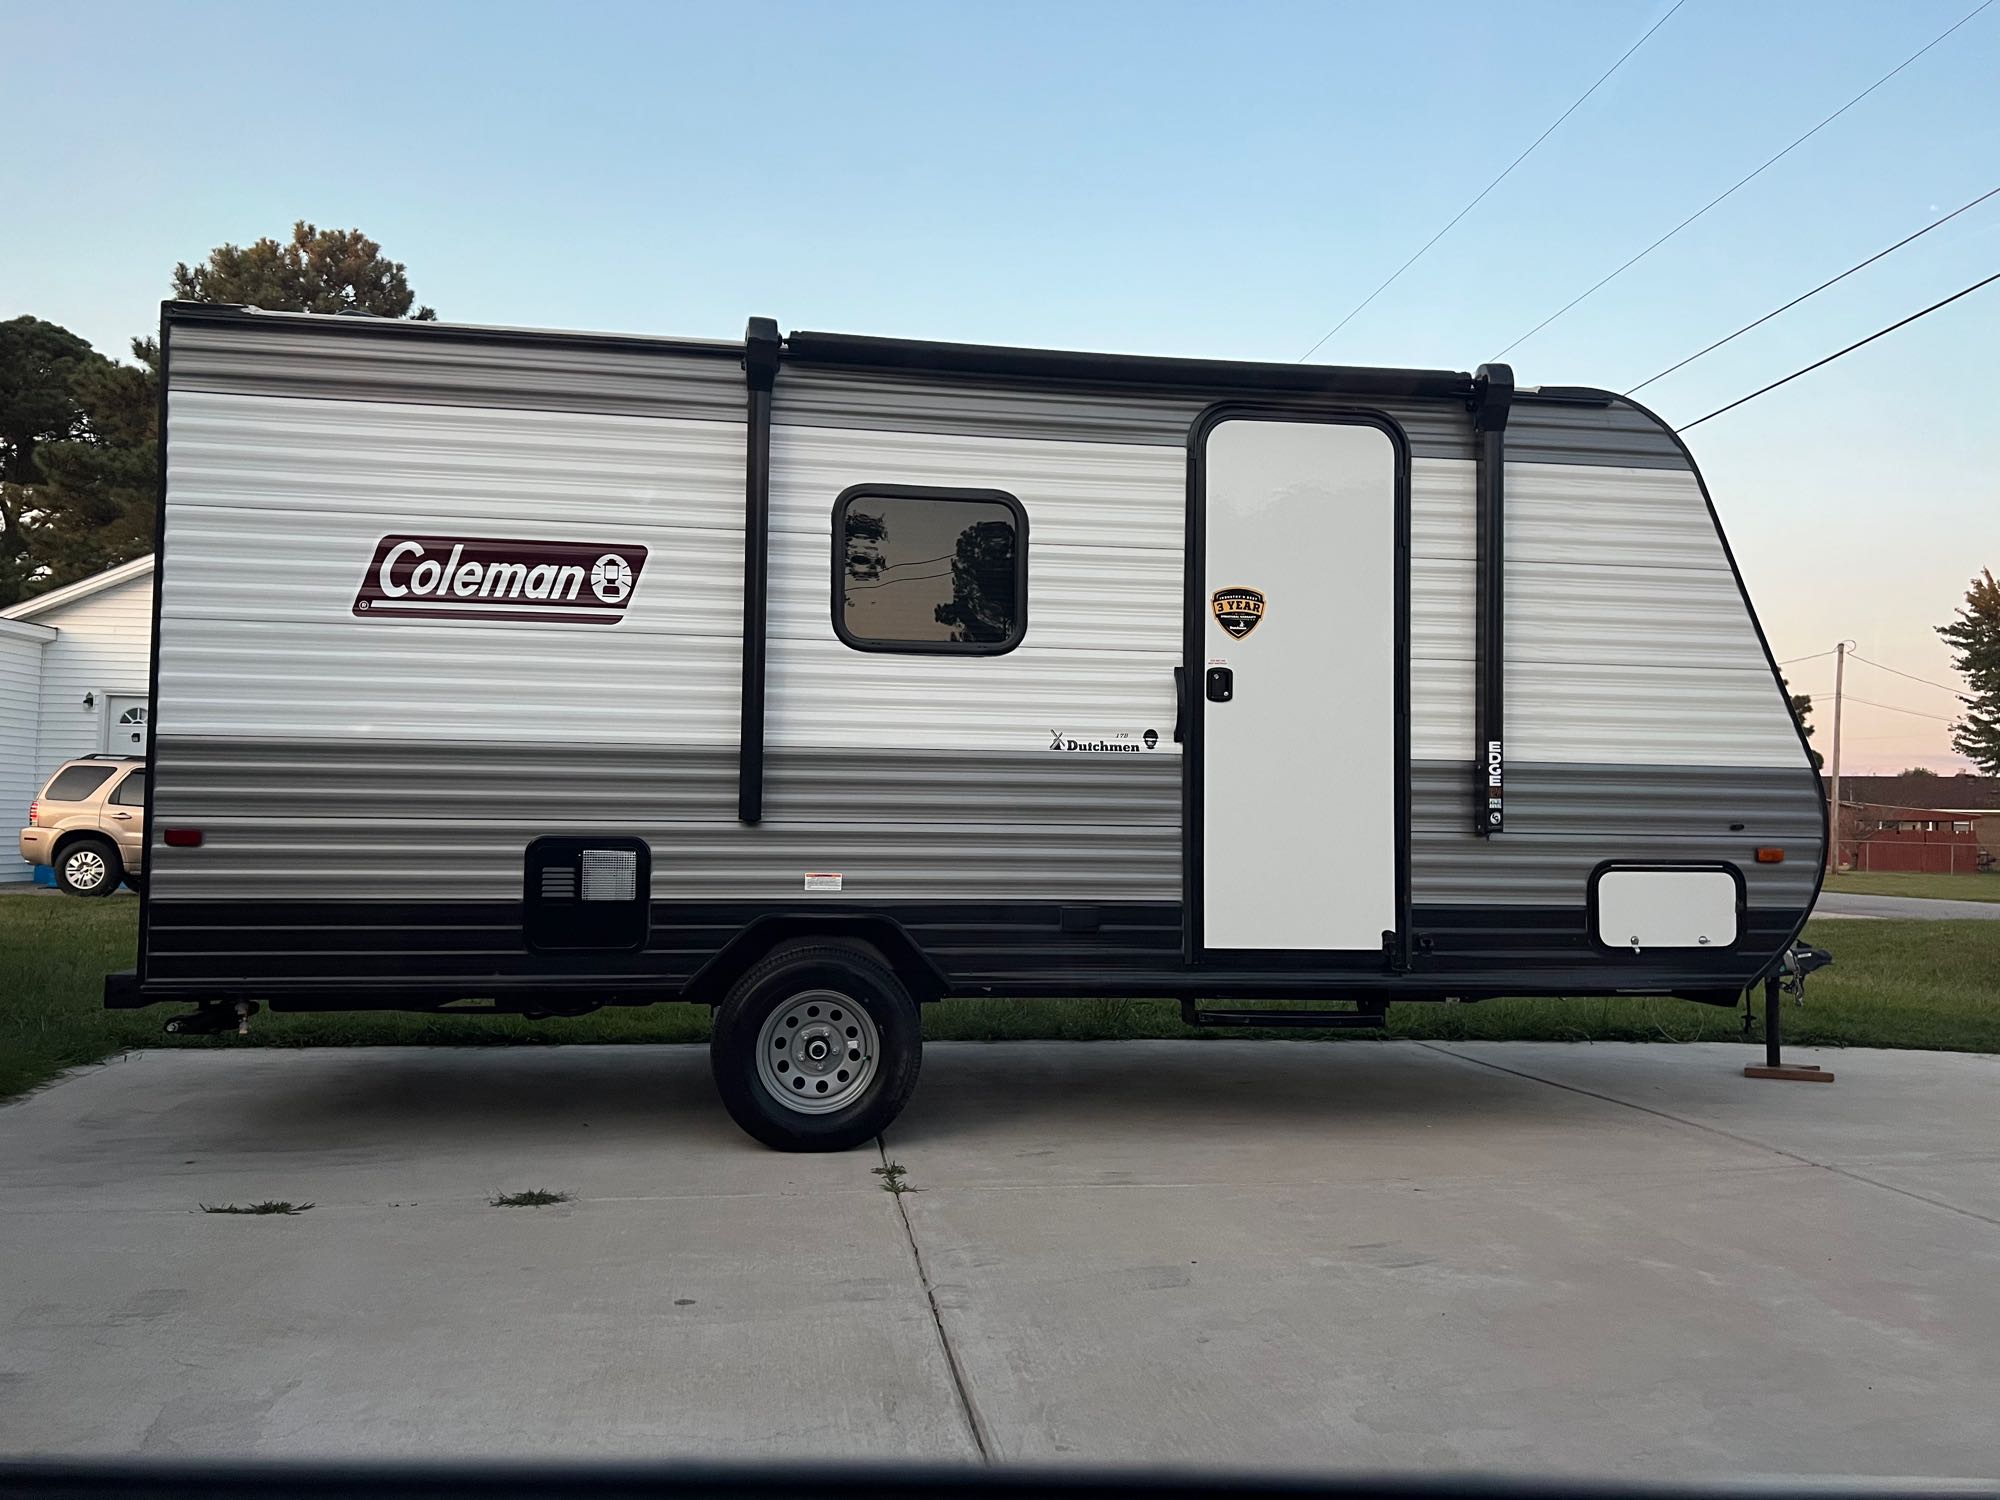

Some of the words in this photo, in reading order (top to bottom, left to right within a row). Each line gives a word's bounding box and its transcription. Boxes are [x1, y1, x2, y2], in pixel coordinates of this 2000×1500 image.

[379, 541, 585, 600] Coleman
[1216, 602, 1224, 612] 3
[1227, 601, 1261, 613] YEAR
[1066, 739, 1140, 752] Dutchmen
[1488, 741, 1502, 787] EDGE
